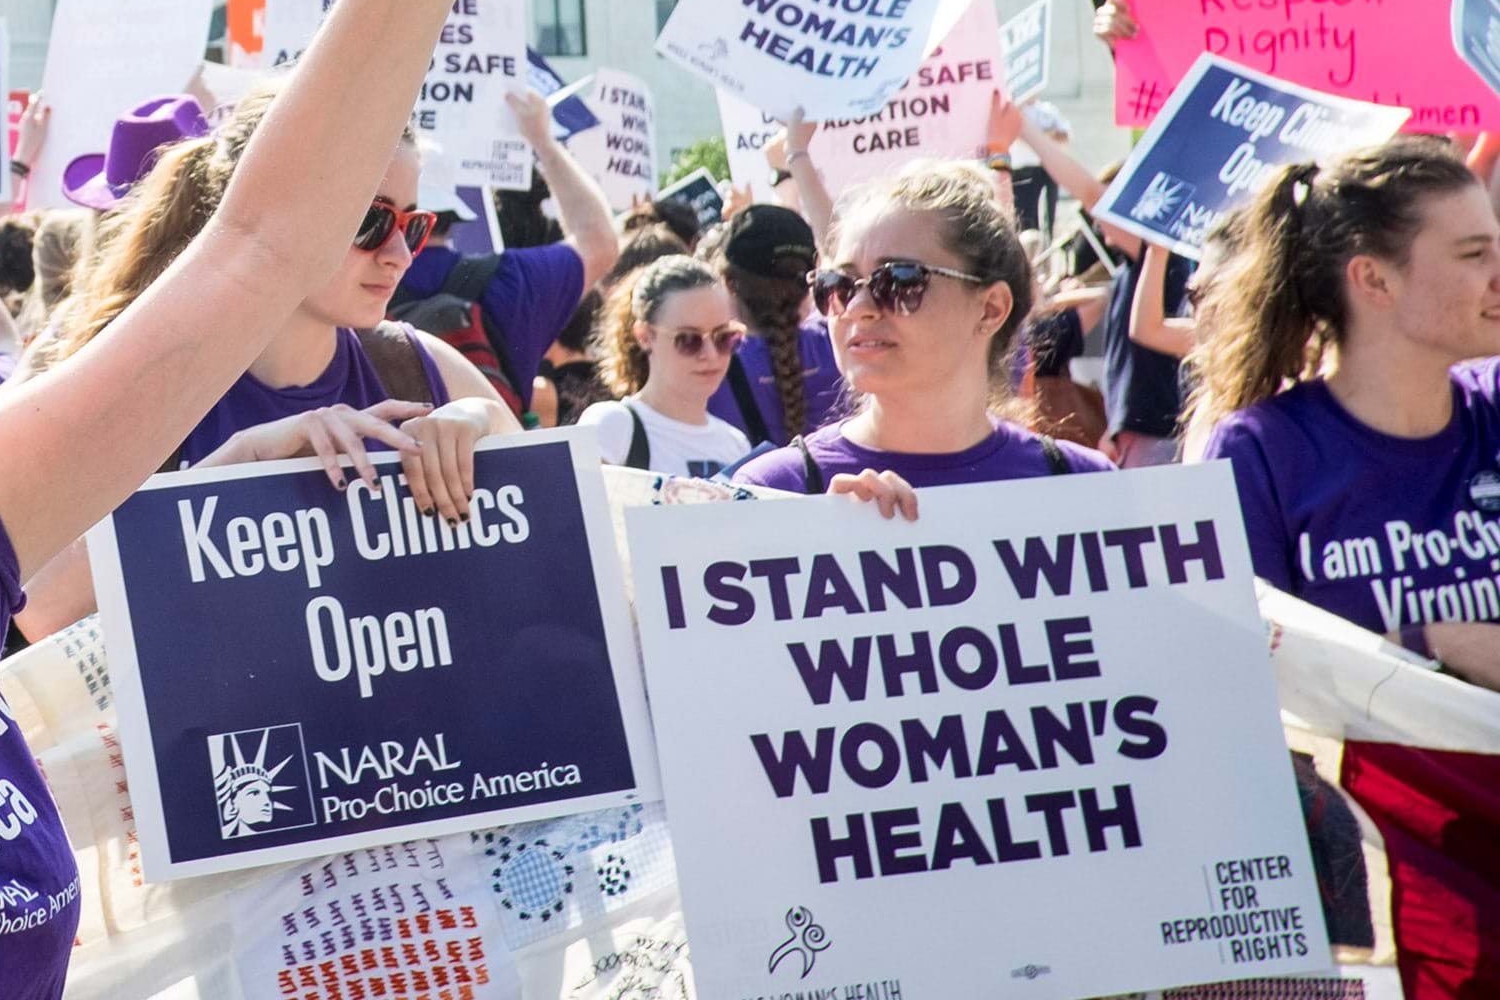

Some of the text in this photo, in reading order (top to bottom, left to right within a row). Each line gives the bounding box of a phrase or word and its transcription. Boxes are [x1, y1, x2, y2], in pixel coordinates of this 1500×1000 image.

[445, 53, 516, 77] SAFE
[739, 21, 880, 78] HEALTH
[918, 60, 993, 88] SAFE
[1206, 13, 1355, 85] Dignity
[1211, 78, 1287, 141] Keep
[853, 128, 921, 154] CARE
[177, 496, 336, 589] Keep
[1299, 532, 1315, 582] I
[1323, 536, 1382, 580] am
[661, 520, 1225, 630] I STAND WITH
[306, 597, 453, 698] Open
[787, 616, 1102, 705] WHOLE
[313, 734, 461, 788] NARAL
[750, 695, 1169, 798] WOMAN'S
[322, 762, 582, 824] Pro-Choice America
[811, 784, 1143, 884] HEALTH
[1215, 855, 1293, 886] CENTER
[1220, 885, 1260, 911] FOR
[1160, 906, 1304, 945] REPRODUCTIVE
[1230, 933, 1309, 964] RIGHTS
[844, 978, 902, 1000] HEALTH
